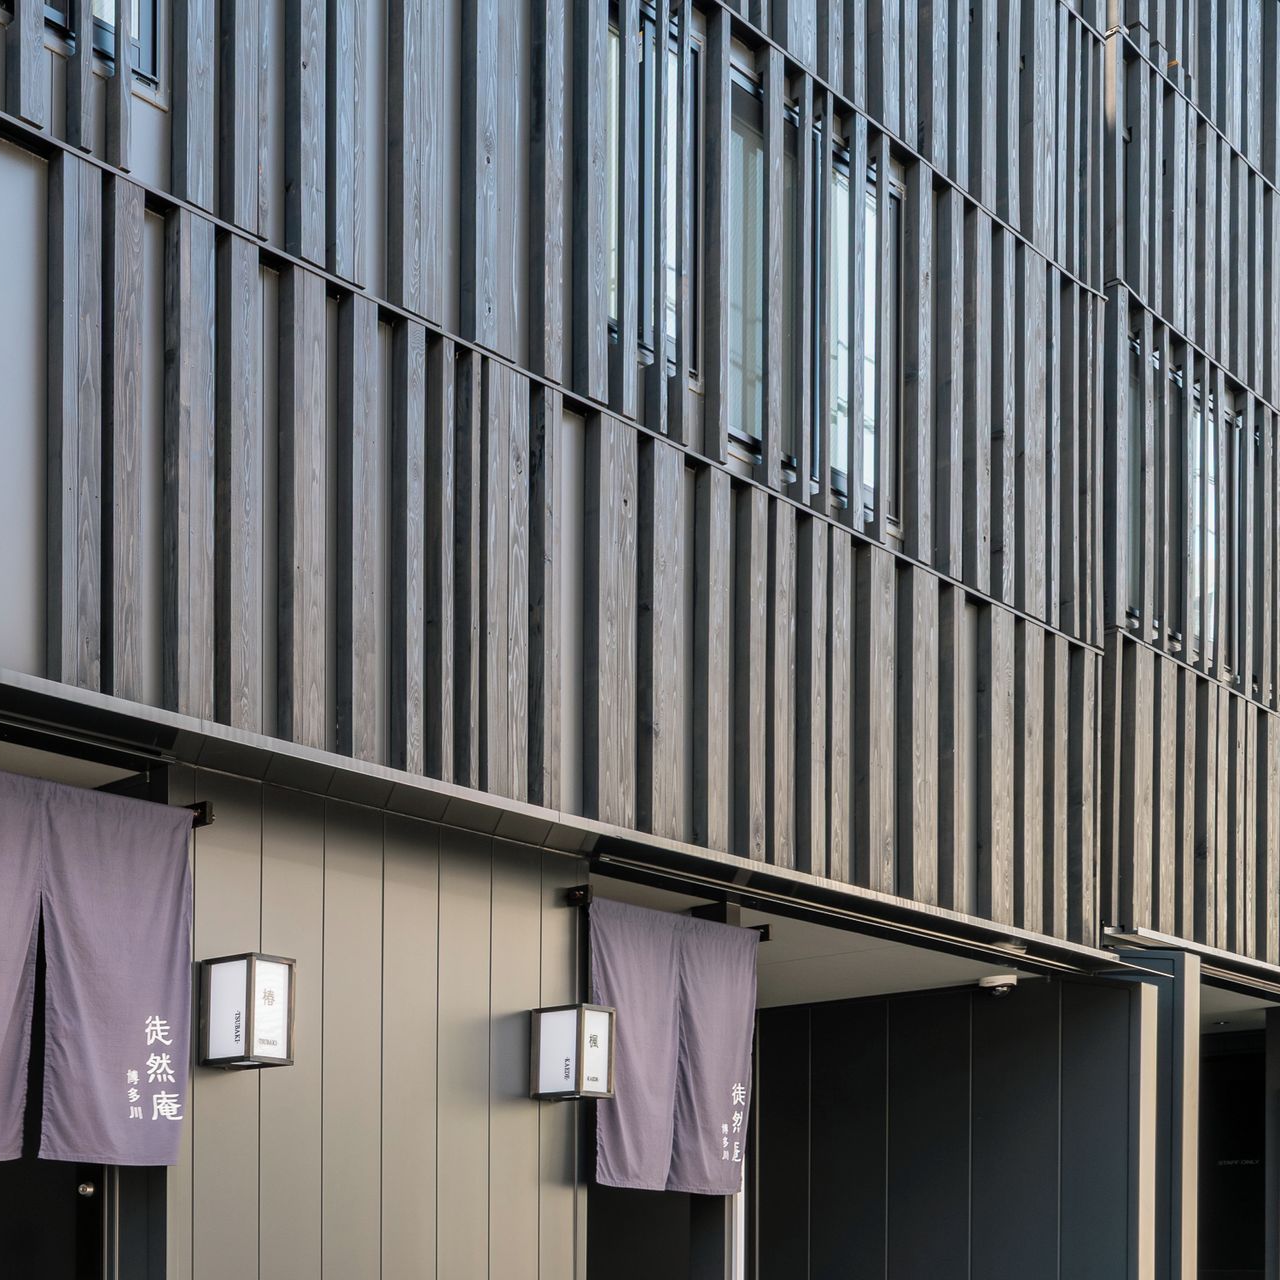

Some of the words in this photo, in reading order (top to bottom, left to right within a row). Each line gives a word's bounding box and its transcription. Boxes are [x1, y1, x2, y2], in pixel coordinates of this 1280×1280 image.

[126, 1069, 144, 1120] 博多川
[144, 1015, 184, 1121] 徒然庵
